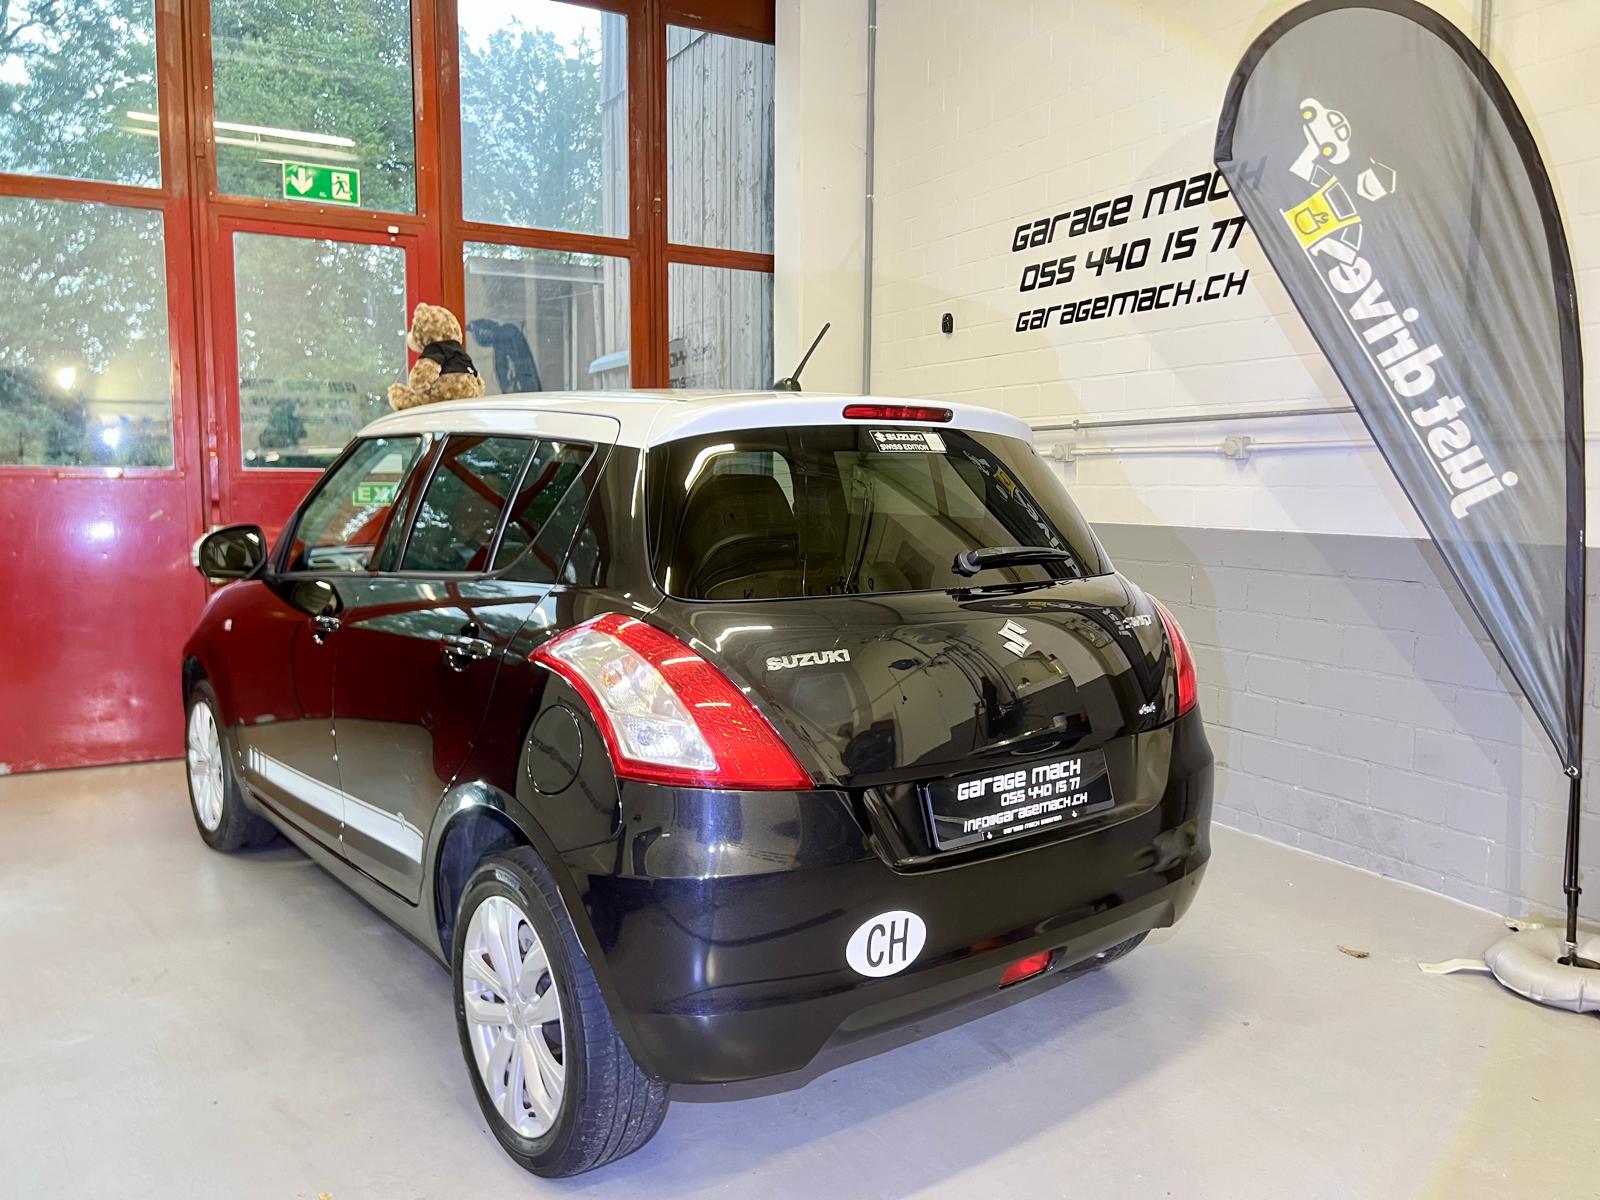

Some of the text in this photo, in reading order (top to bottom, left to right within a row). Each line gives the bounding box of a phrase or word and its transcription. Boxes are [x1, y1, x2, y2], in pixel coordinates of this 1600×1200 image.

[1012, 194, 1133, 252] Garage
[1019, 216, 1248, 292] 055 440 15 77
[880, 443, 902, 451] SWISS
[885, 433, 923, 441] SUZUKI
[766, 649, 850, 671] SUZUKI
[957, 770, 1026, 800] Garage
[1000, 776, 1081, 806] 055 440 15 77
[866, 917, 909, 968] CH
